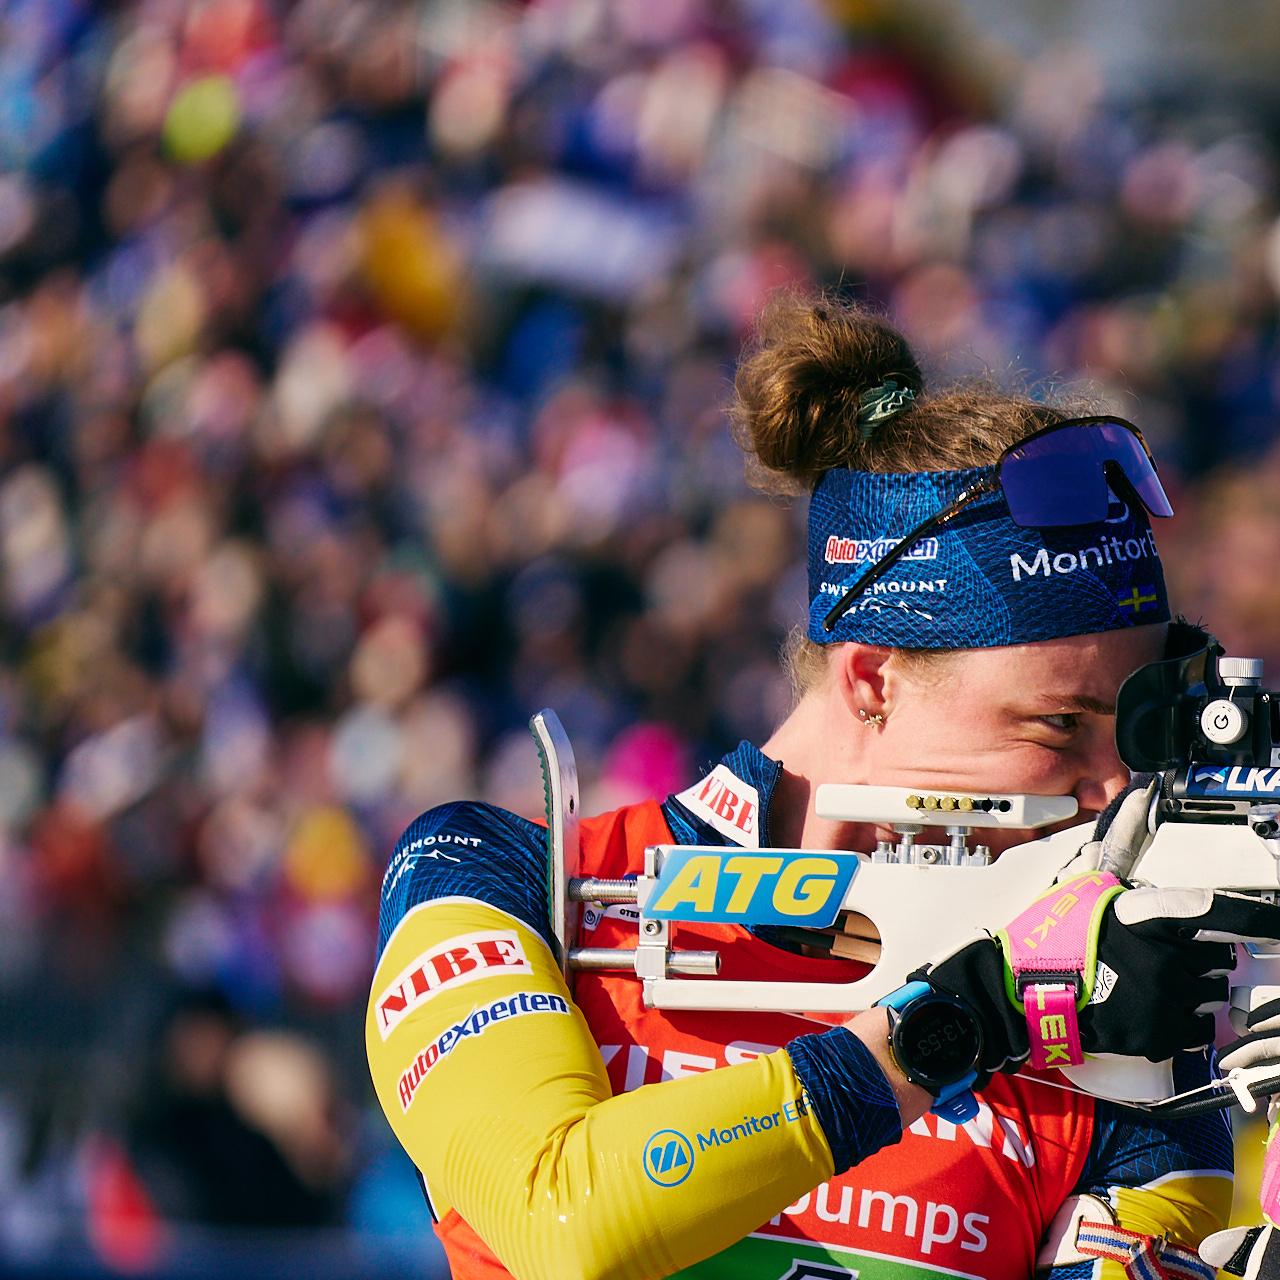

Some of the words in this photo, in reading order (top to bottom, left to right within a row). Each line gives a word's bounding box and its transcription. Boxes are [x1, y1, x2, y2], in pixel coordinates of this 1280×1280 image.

[827, 538, 935, 563] Autoexpeen
[1010, 535, 1148, 581] Monitor
[819, 579, 948, 597] SWEEMOUNT
[692, 777, 757, 836] NIBE
[381, 835, 482, 893] DEMOUNT
[653, 856, 839, 917] ATG
[1023, 876, 1103, 950] LEKI
[380, 939, 526, 1031] NIBE
[398, 992, 570, 1109] Autoexperten
[697, 1111, 780, 1151] Monitor
[771, 1184, 990, 1254] pumps
